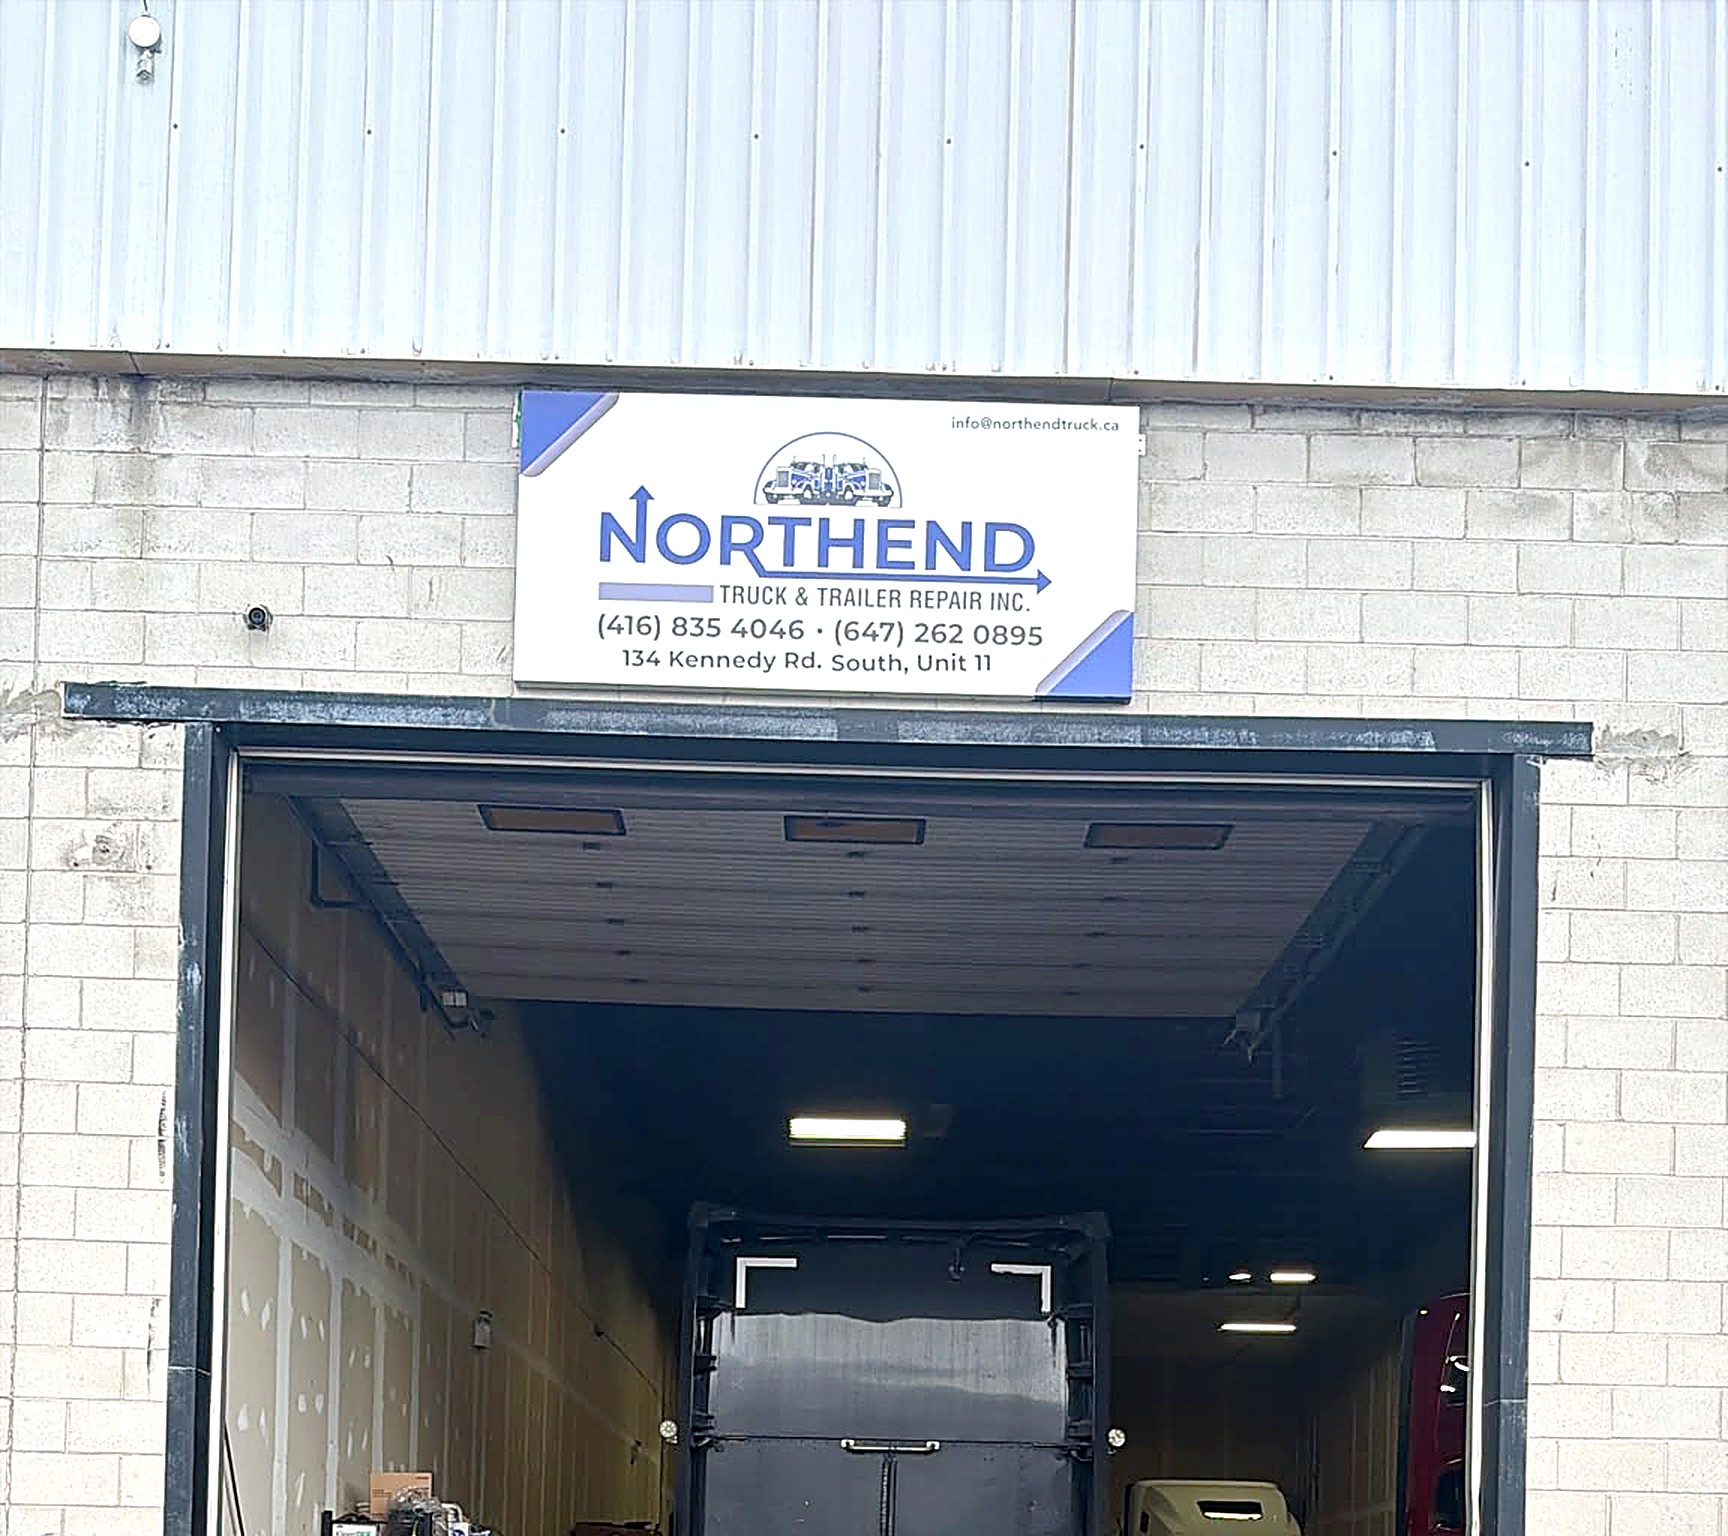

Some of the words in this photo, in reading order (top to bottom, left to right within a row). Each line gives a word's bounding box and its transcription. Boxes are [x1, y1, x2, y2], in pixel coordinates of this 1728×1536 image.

[951, 415, 1119, 431] info@northendtruck.ca
[599, 508, 1036, 575] NORTHEND
[719, 584, 787, 607] TRUCK
[794, 586, 809, 607] &
[816, 587, 901, 609] TRAILER
[909, 589, 982, 611] REPAIR
[990, 592, 1031, 612] INC.
[598, 613, 661, 642] (416)
[671, 615, 721, 638] 835
[730, 617, 805, 640] 4046
[834, 619, 904, 649] (647)
[914, 622, 964, 645] 262
[973, 624, 1043, 647] 0895
[622, 649, 661, 668] 134
[669, 650, 776, 674] Kennedy
[785, 651, 822, 670] Rd.
[831, 653, 909, 675] South,
[916, 654, 967, 672] Unit
[974, 654, 992, 672] 11
